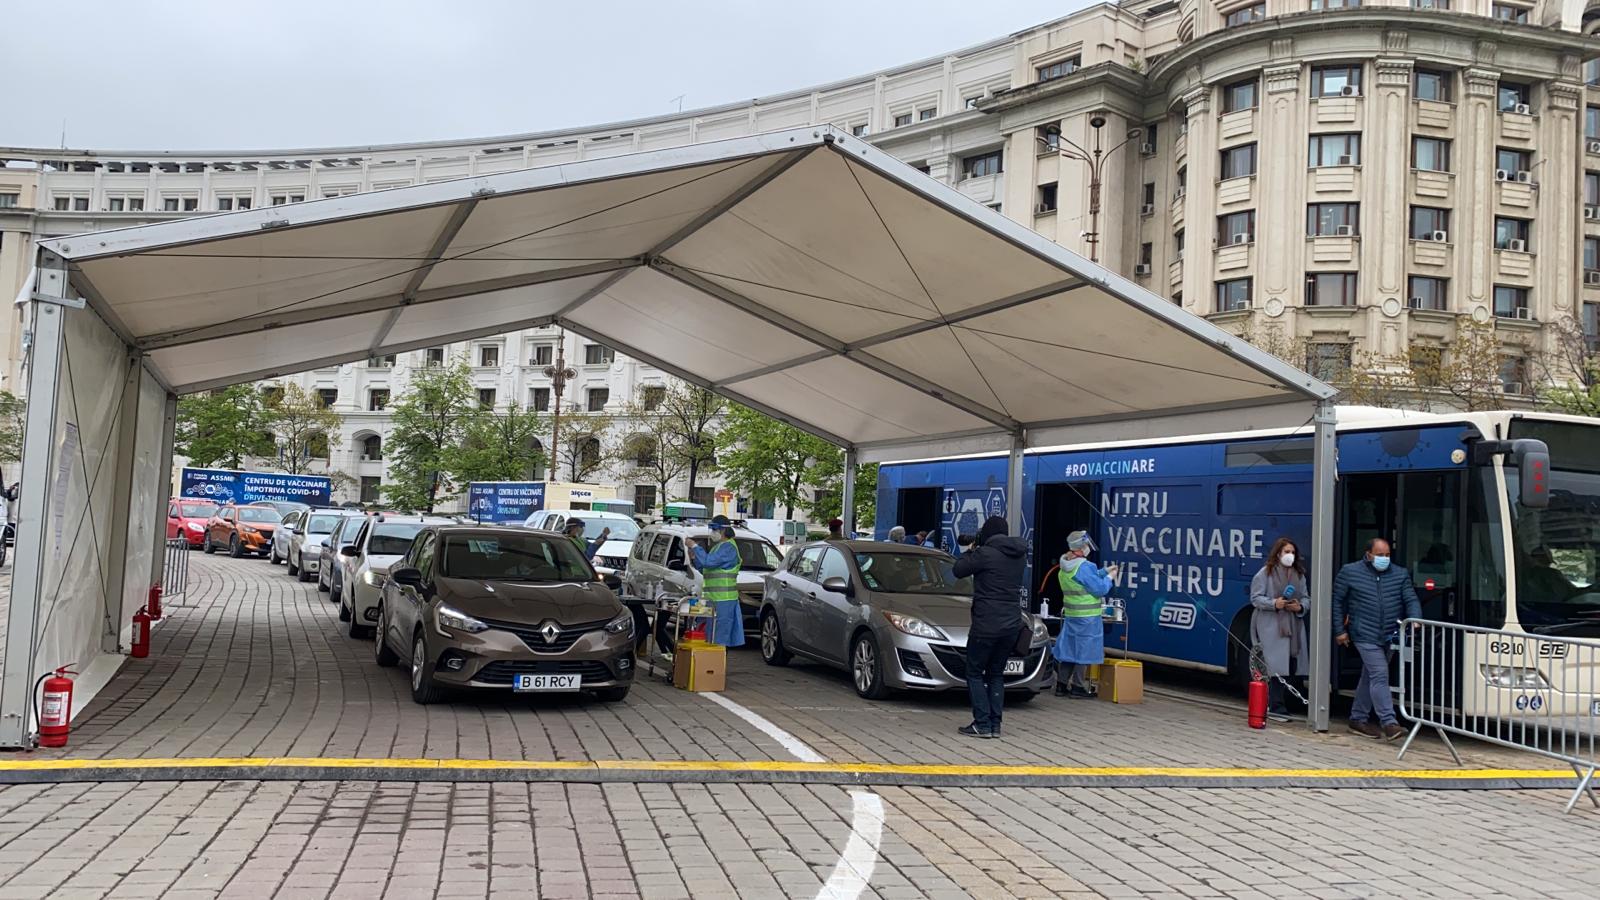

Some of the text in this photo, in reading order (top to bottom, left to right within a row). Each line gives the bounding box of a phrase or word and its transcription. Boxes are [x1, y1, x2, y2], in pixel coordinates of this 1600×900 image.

[1065, 458, 1155, 477] #ROVACCINARE
[245, 477, 274, 485] CENTRU
[287, 480, 328, 488] VACCINARE
[287, 488, 320, 496] COVID-19
[1108, 526, 1264, 559] VACCINARE
[1158, 606, 1194, 625] STB
[1490, 641, 1524, 656] 6210
[522, 676, 575, 688] B 61 RCY
